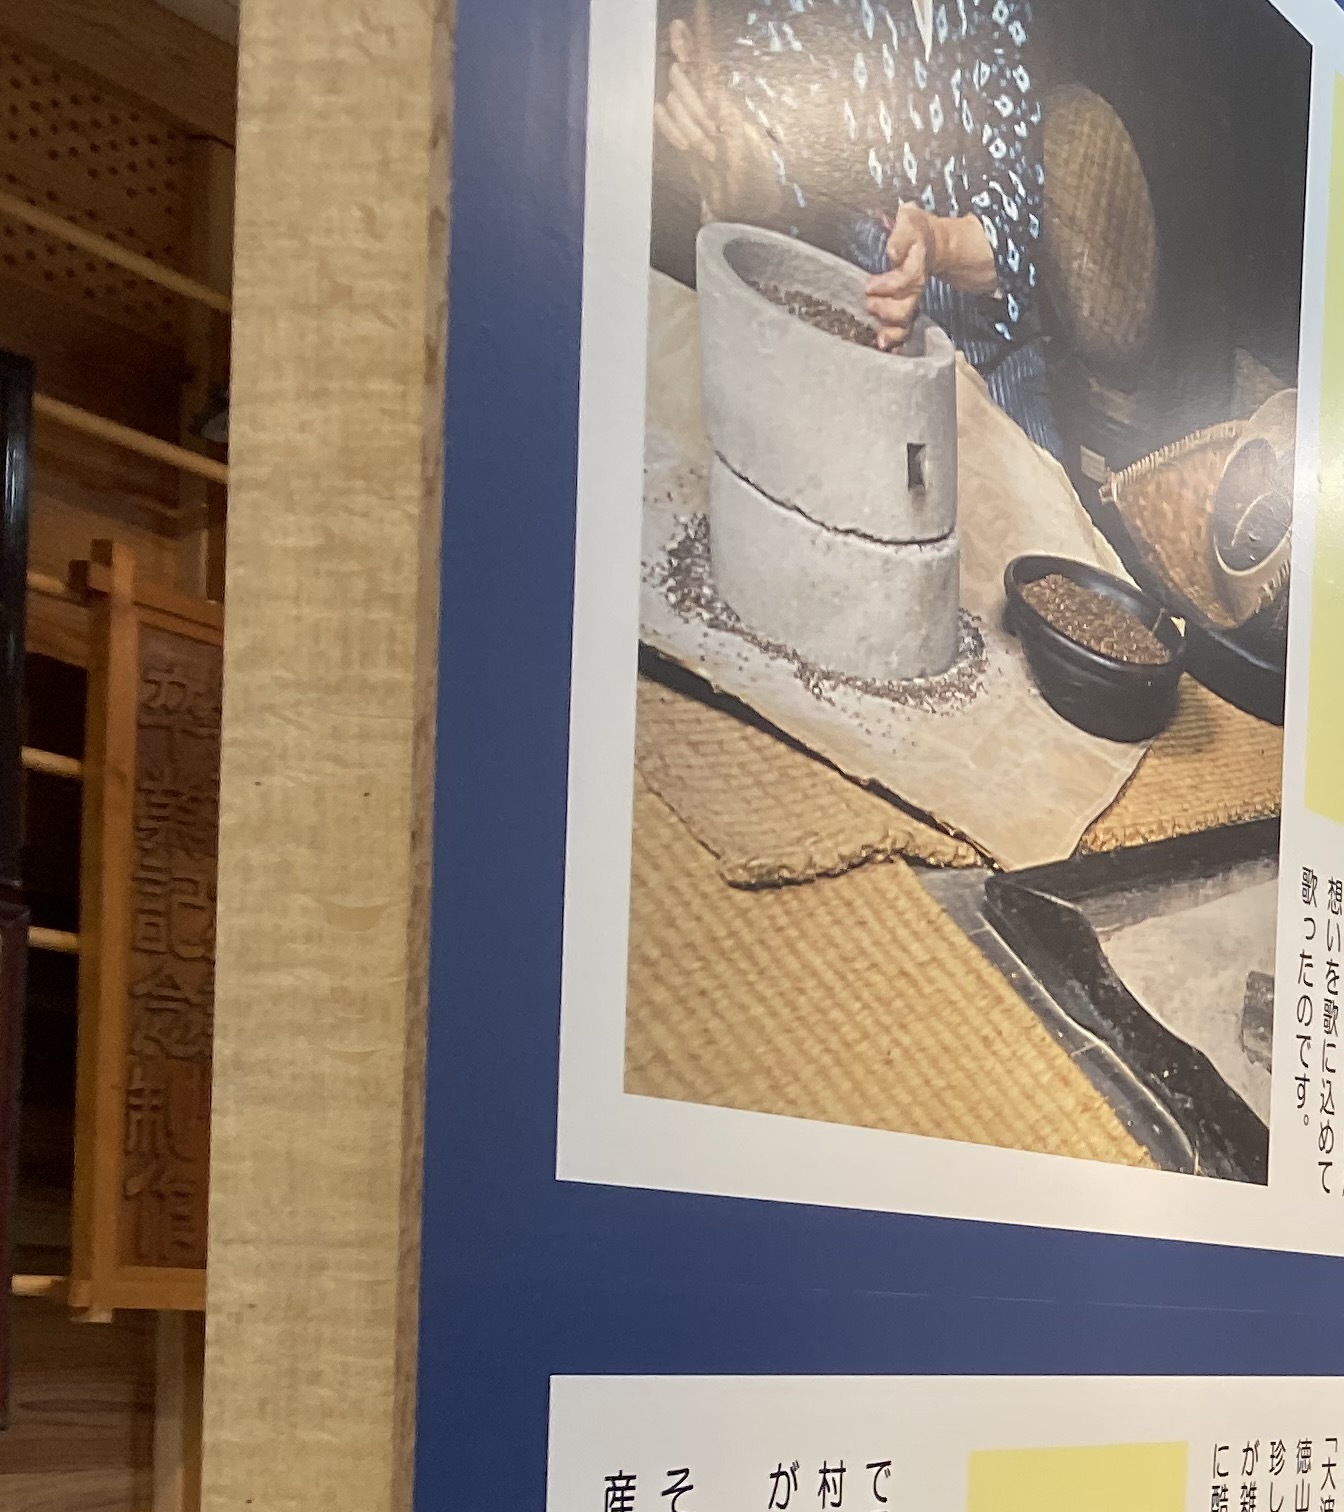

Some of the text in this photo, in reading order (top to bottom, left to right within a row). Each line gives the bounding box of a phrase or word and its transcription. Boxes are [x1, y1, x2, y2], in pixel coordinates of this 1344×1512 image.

[1293, 865, 1318, 1126] 歌ったのです。
[1317, 875, 1343, 1194] 想いを歌に込めて
